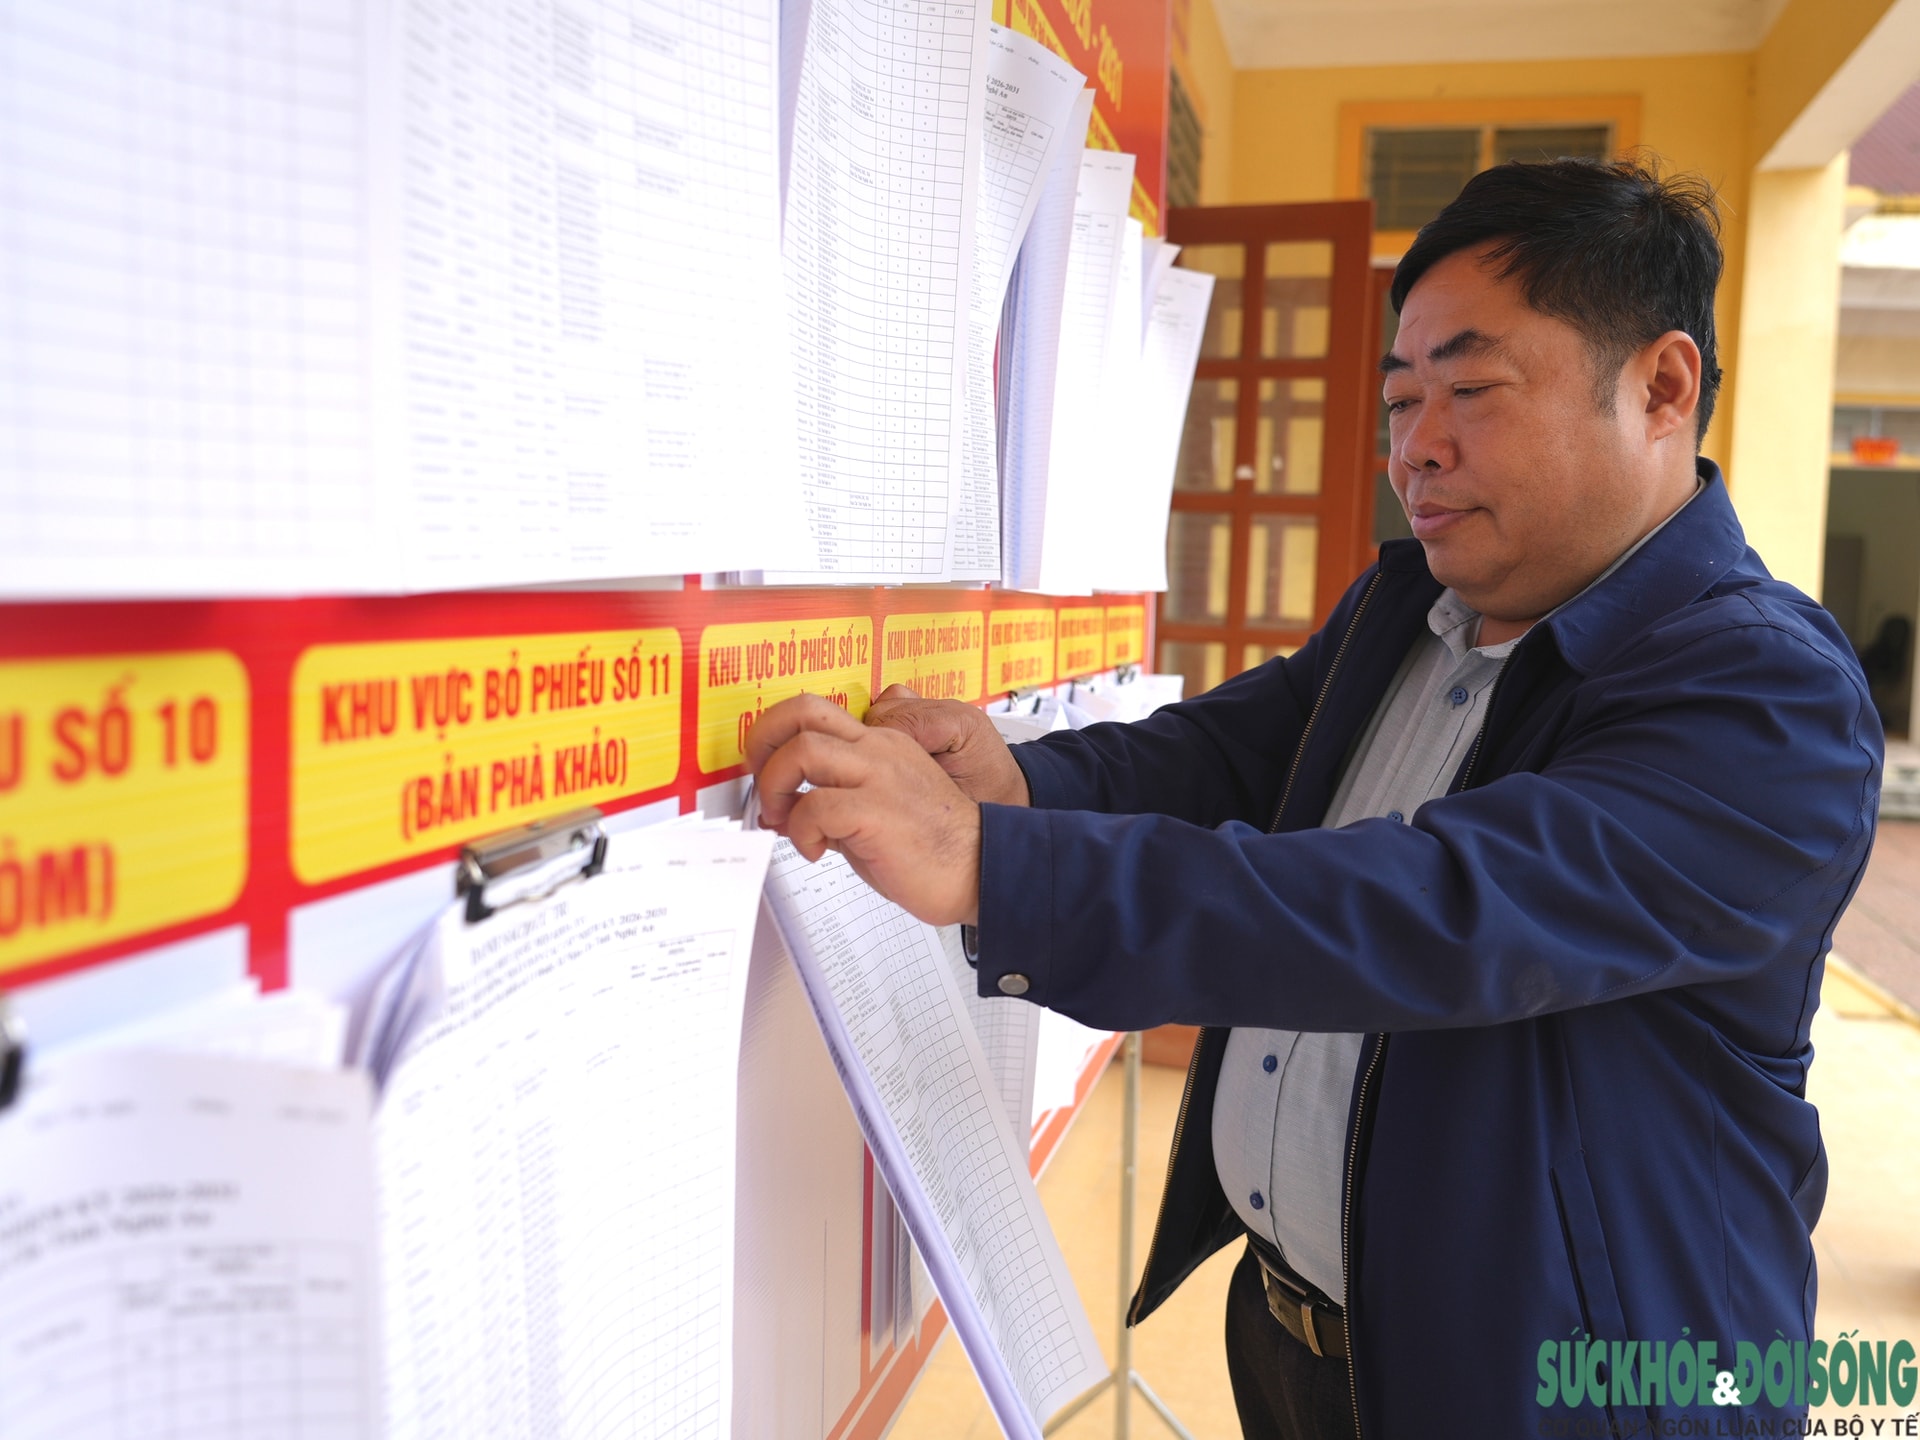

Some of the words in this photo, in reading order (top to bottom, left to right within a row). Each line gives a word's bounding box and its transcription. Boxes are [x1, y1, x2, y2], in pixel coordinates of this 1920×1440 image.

[321, 677, 398, 745] KHU
[410, 667, 473, 741] VỰC
[484, 649, 521, 722] BỎ
[531, 644, 605, 713] PHIẾU
[613, 639, 643, 702] SỐ
[650, 653, 670, 697] 11
[708, 645, 741, 687] KHU
[746, 639, 774, 688] VỰC
[778, 628, 795, 677] BỎ
[800, 625, 836, 674] PHIẾU
[838, 623, 854, 669] SỐ
[856, 634, 868, 666] 12
[887, 630, 906, 661] KHU
[908, 626, 924, 663] VỰC
[925, 618, 936, 656] BỎ
[937, 618, 960, 654] PHIẾU
[961, 616, 971, 650] SỐ
[973, 625, 980, 649] 13
[52, 671, 132, 784] SỐ
[158, 695, 218, 768] 10
[402, 752, 478, 841] (BẢN
[491, 743, 545, 813] PHÀ
[554, 726, 628, 798] KHẢO)
